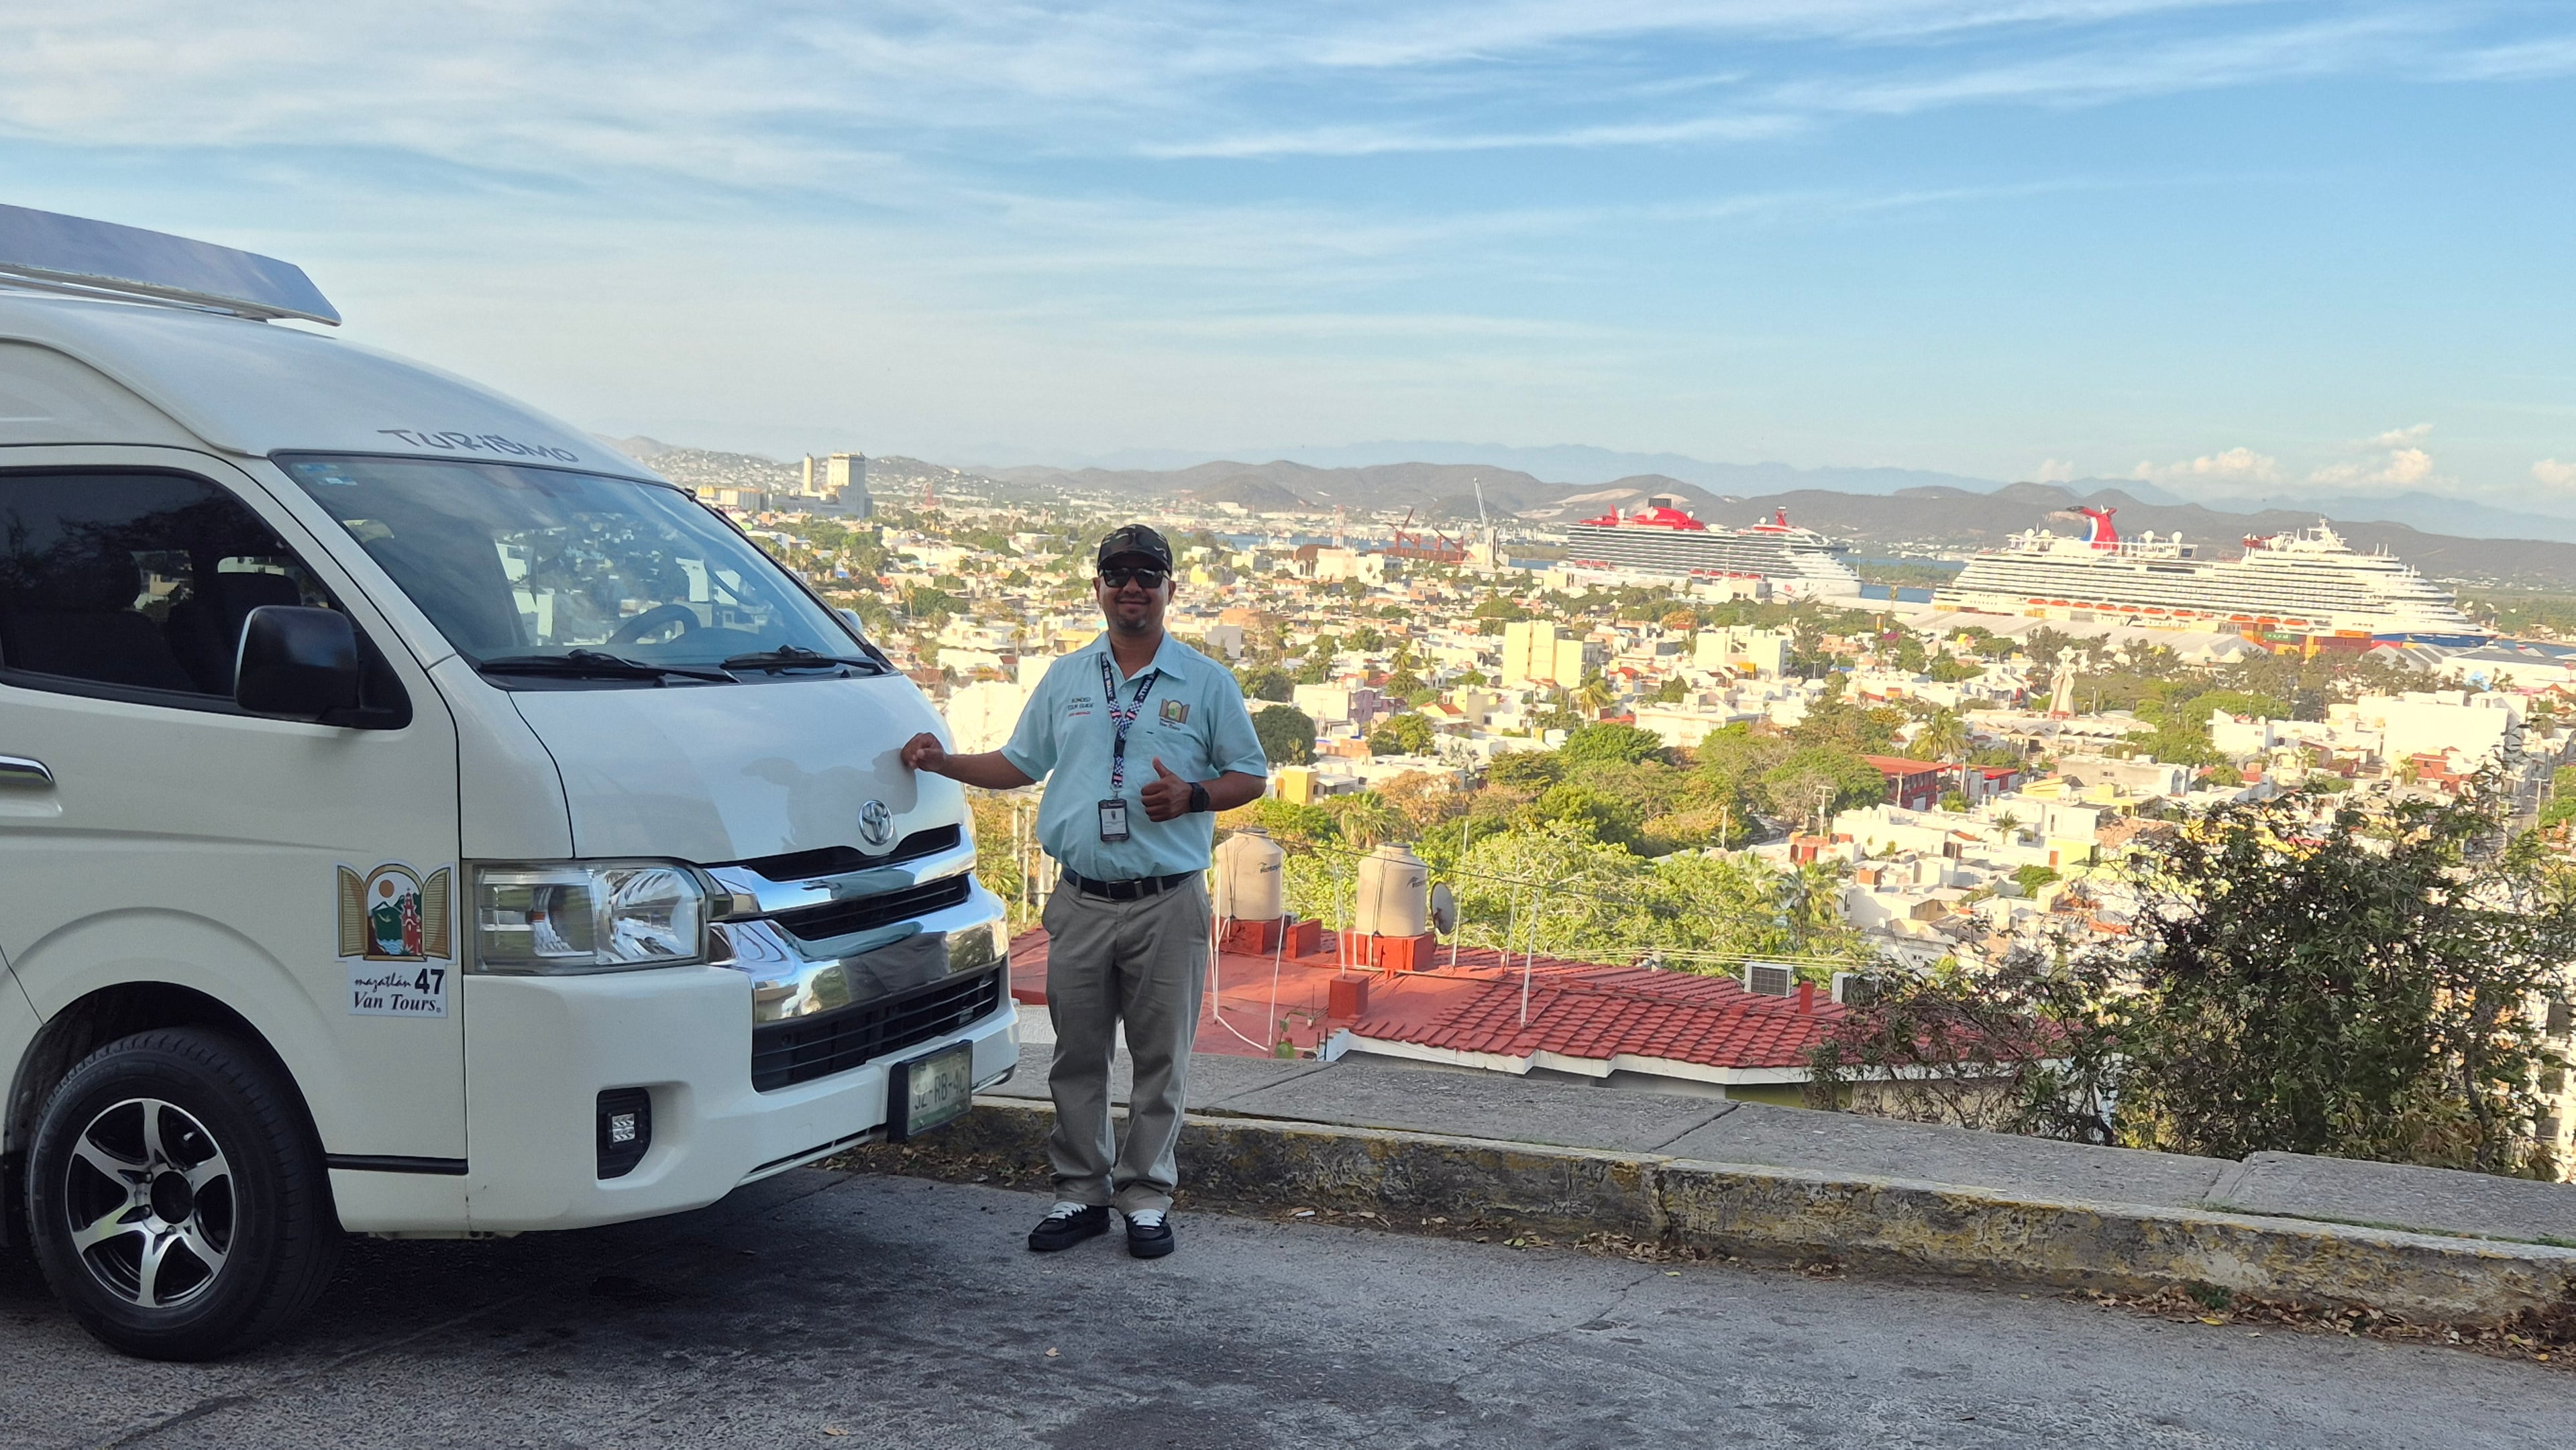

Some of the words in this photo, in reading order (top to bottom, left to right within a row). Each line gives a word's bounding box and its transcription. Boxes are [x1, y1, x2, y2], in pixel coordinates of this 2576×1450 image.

[376, 429, 580, 463] TURISMO
[415, 968, 445, 995] 47
[354, 991, 383, 1009] Van
